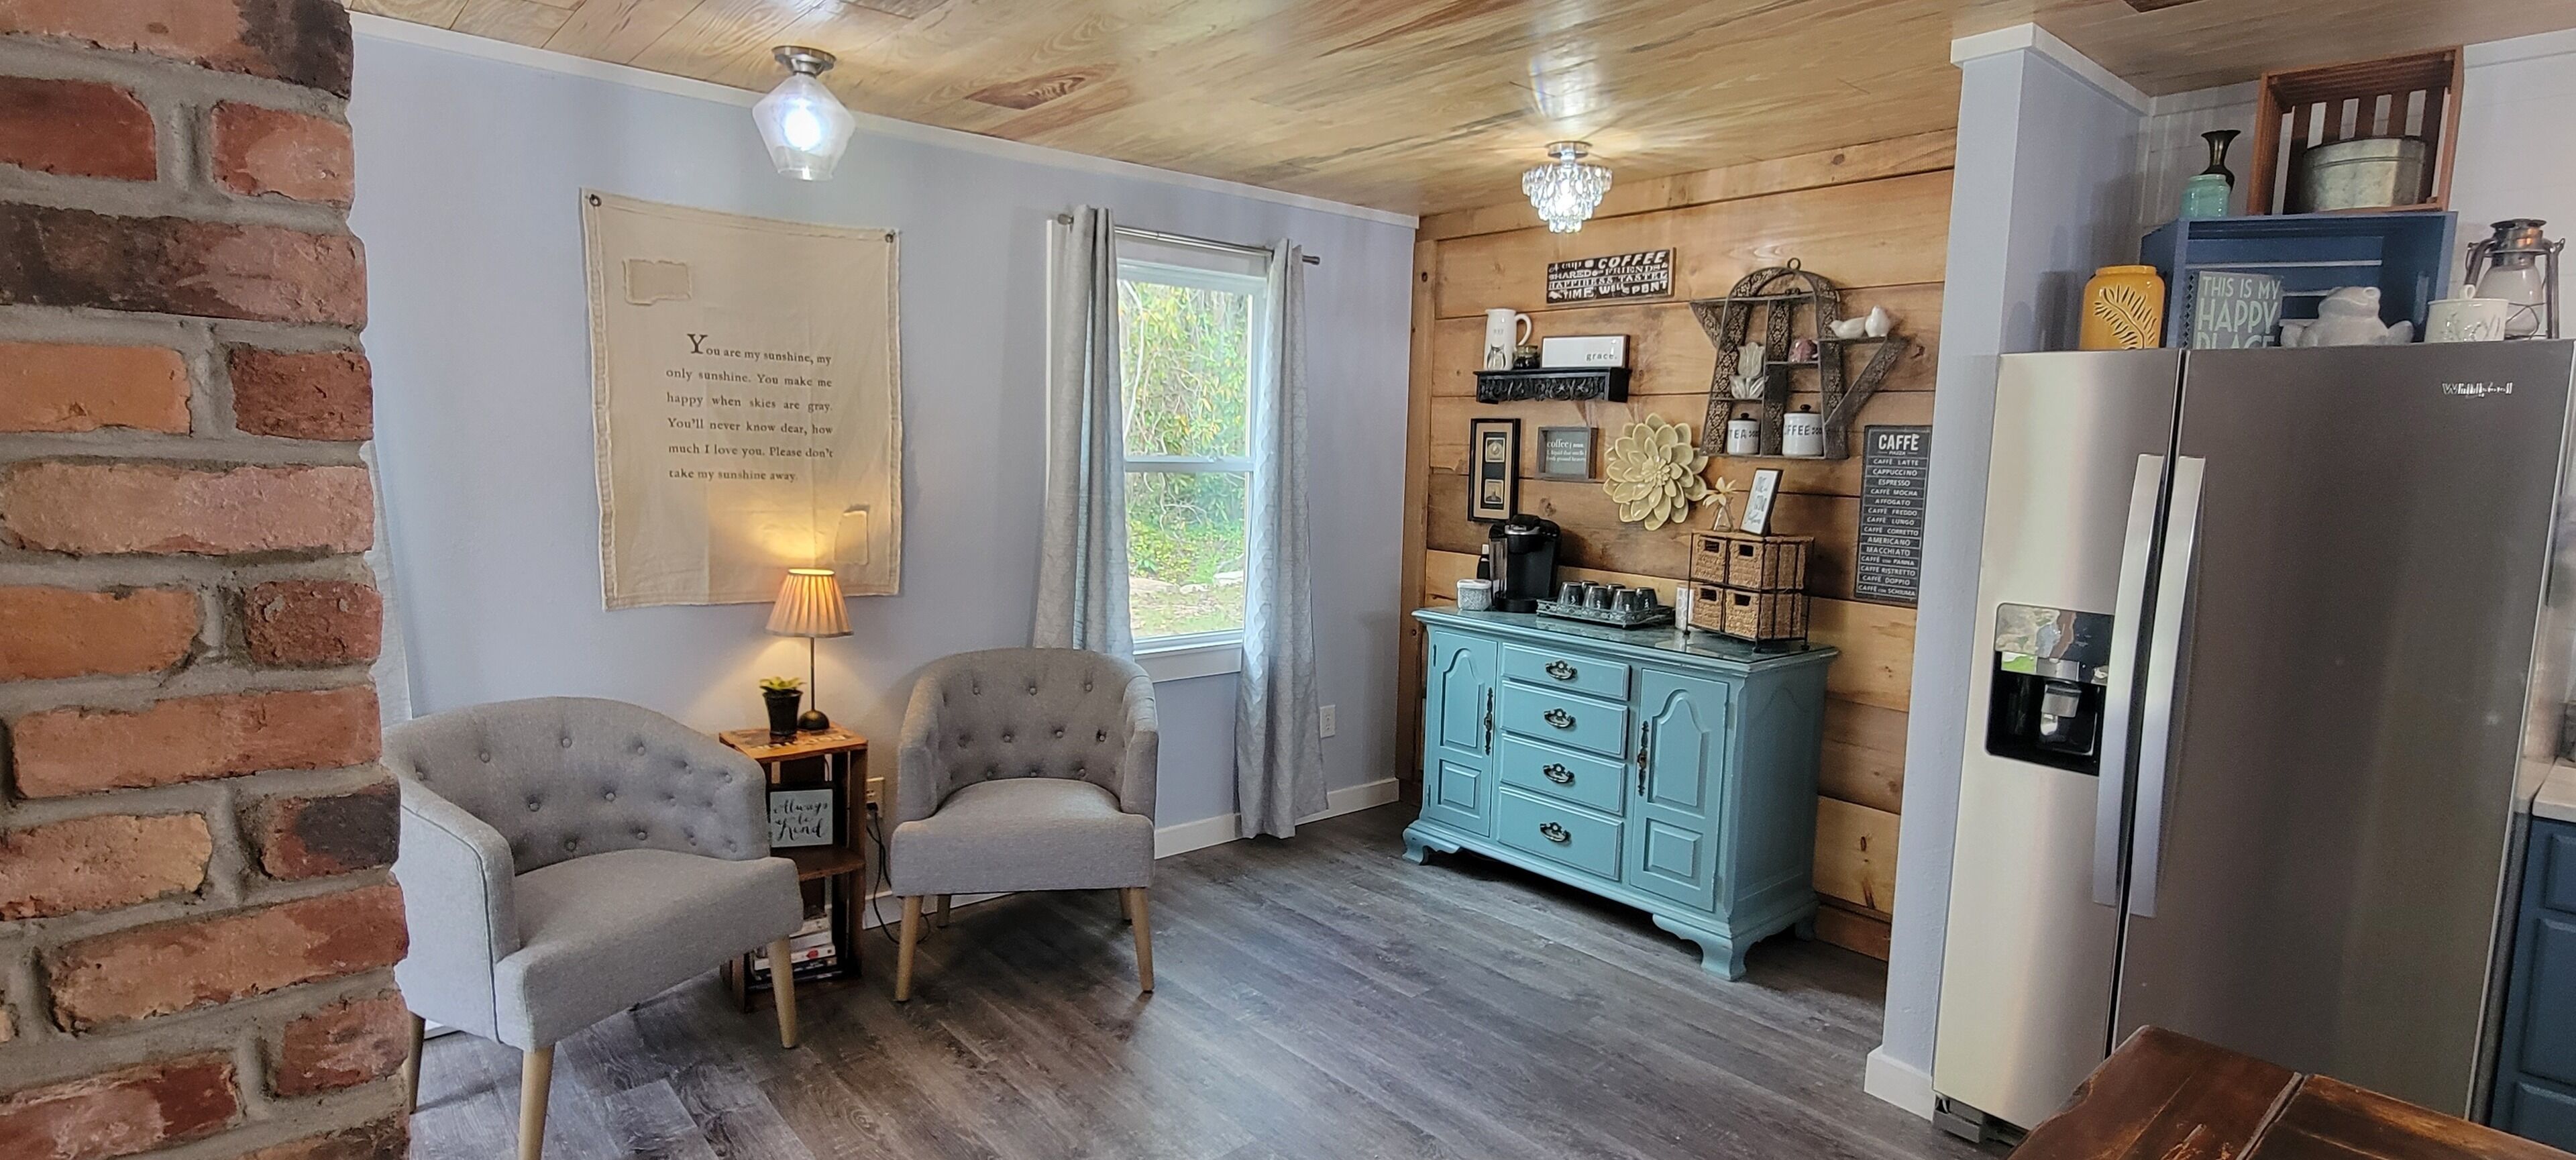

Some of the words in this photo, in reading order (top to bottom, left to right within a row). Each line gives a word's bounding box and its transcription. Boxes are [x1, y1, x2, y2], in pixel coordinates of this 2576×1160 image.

[1598, 251, 1667, 269] COFFEE
[1548, 269, 1591, 280] SHARED
[1605, 264, 1660, 276] FRIENDS
[1563, 287, 1595, 299] TIME
[2202, 276, 2234, 297] THIS
[2240, 278, 2252, 298] IS
[2258, 280, 2281, 299] MY
[2198, 298, 2278, 334] HAPPY
[687, 333, 720, 356] You
[723, 350, 741, 358] are
[744, 351, 760, 362] my
[763, 351, 814, 365] sunshine,
[816, 356, 832, 366] my
[1586, 353, 1618, 362] grace.
[666, 368, 692, 382] only
[698, 370, 751, 383] sunshine.
[757, 374, 779, 384] You
[784, 375, 812, 386] make
[666, 392, 703, 407] happy
[712, 395, 741, 407] when
[749, 397, 776, 409] skies
[808, 403, 833, 413] gray.
[667, 417, 704, 429] You'll
[710, 421, 741, 431] never
[746, 421, 775, 431] know
[780, 423, 808, 435] dear,
[812, 424, 833, 434] how
[1729, 429, 1747, 439] TEA
[1546, 439, 1569, 447] coffee
[668, 443, 700, 454] much
[704, 444, 710, 454] I
[714, 443, 738, 455] love
[741, 447, 765, 458] you.
[769, 447, 802, 457] Please
[805, 447, 834, 458] don't
[669, 468, 694, 478] take
[698, 471, 714, 481] my
[718, 469, 766, 480] sunshine
[769, 472, 798, 483] away.
[1872, 468, 1918, 476] CAPPUCCINO
[1878, 478, 1911, 486] ESPRESSO
[1887, 528, 1919, 536] CORRETTO
[1867, 537, 1911, 546] AMERICANO
[1866, 546, 1911, 556] MACCHIATO
[1881, 568, 1916, 576] RISTRETTO
[1884, 577, 1911, 586] DOPPIO
[773, 798, 828, 816] Always
